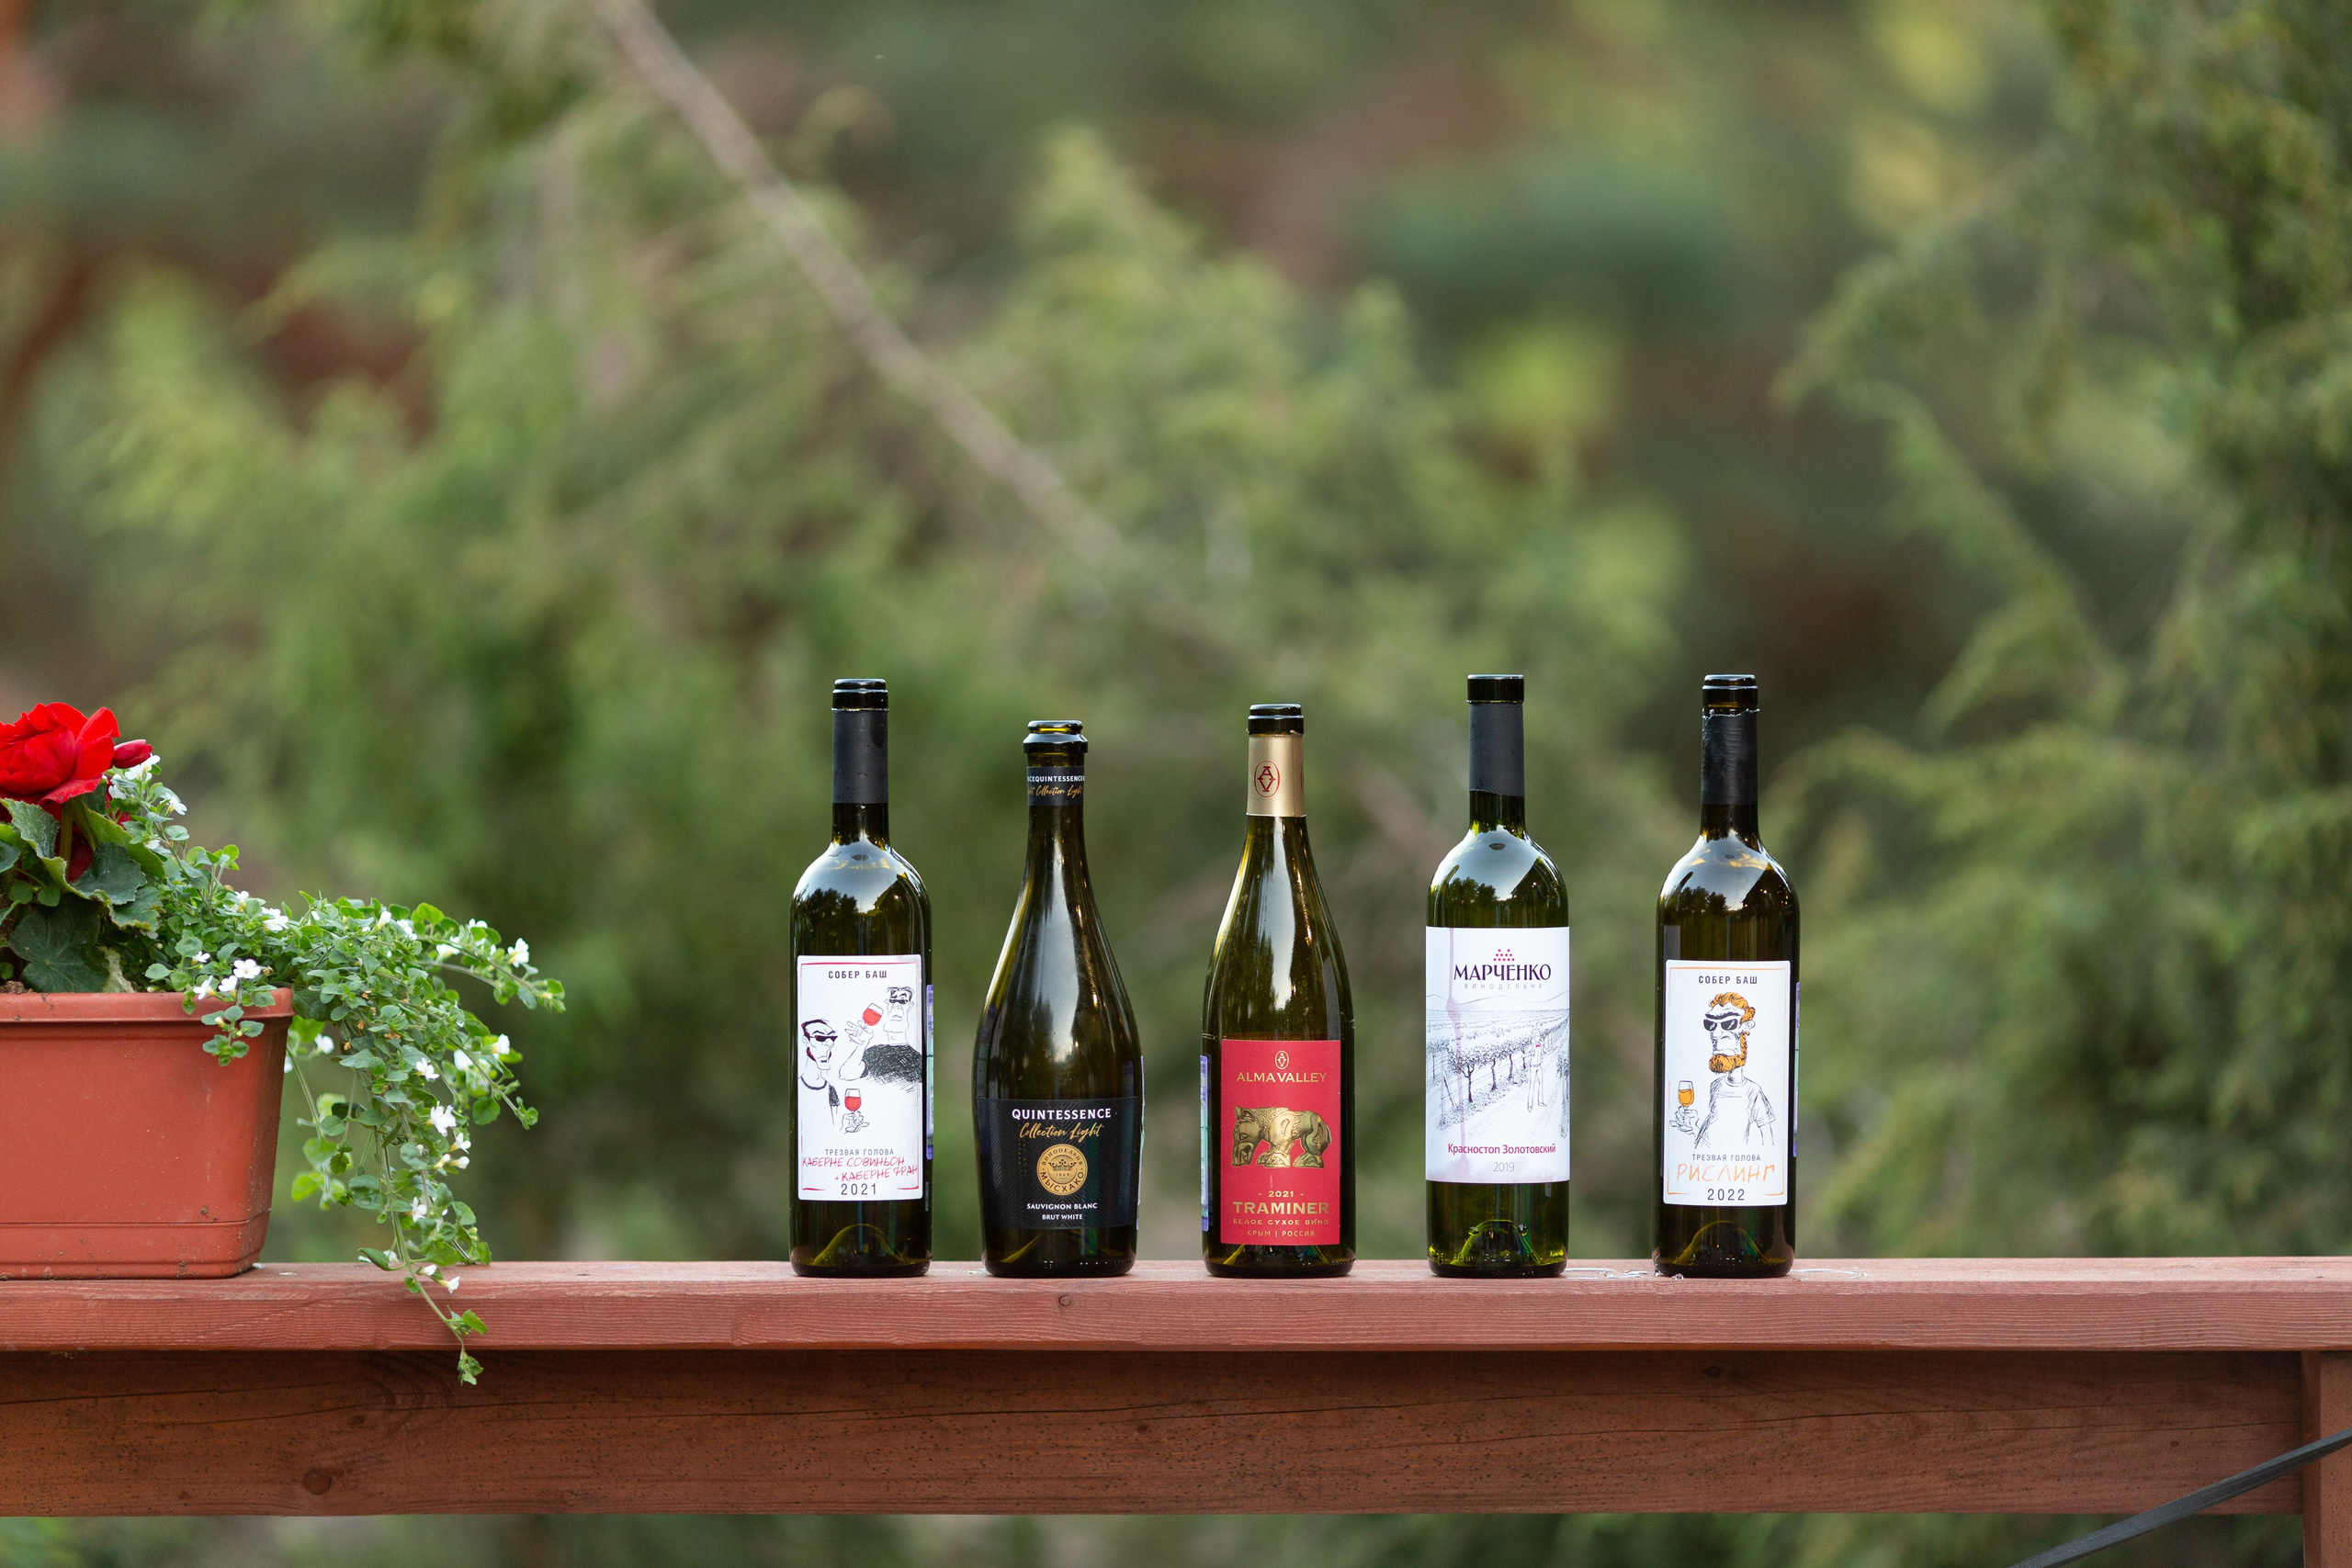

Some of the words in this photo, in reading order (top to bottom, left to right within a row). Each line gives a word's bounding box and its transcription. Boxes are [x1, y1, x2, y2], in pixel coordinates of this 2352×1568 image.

[828, 970, 860, 979] СОБЕР
[865, 970, 888, 979] БАШ
[1453, 964, 1552, 981] МАРЧЕНКО
[1698, 975, 1731, 985] СОБЕР
[1736, 976, 1758, 985] БАШ
[1012, 1108, 1112, 1121] QUINTESSENCE
[1019, 1122, 1067, 1139] Collection
[1069, 1122, 1104, 1143] Light
[1447, 1143, 1500, 1156] Красностоп
[1502, 1143, 1556, 1155] Золотовский
[802, 1156, 844, 1168] КАБЕРНЕ
[846, 1156, 905, 1168] СОВИНЬОН
[1493, 1161, 1515, 1172] 2019
[842, 1167, 891, 1182] КАБЕРНЕ
[1676, 1163, 1775, 1183] РИСЛИНГ
[1039, 1171, 1084, 1192] МЫСХАКО
[840, 1183, 877, 1195] 2021
[1707, 1188, 1746, 1201] 2022
[1232, 1201, 1329, 1215] TRAMINER
